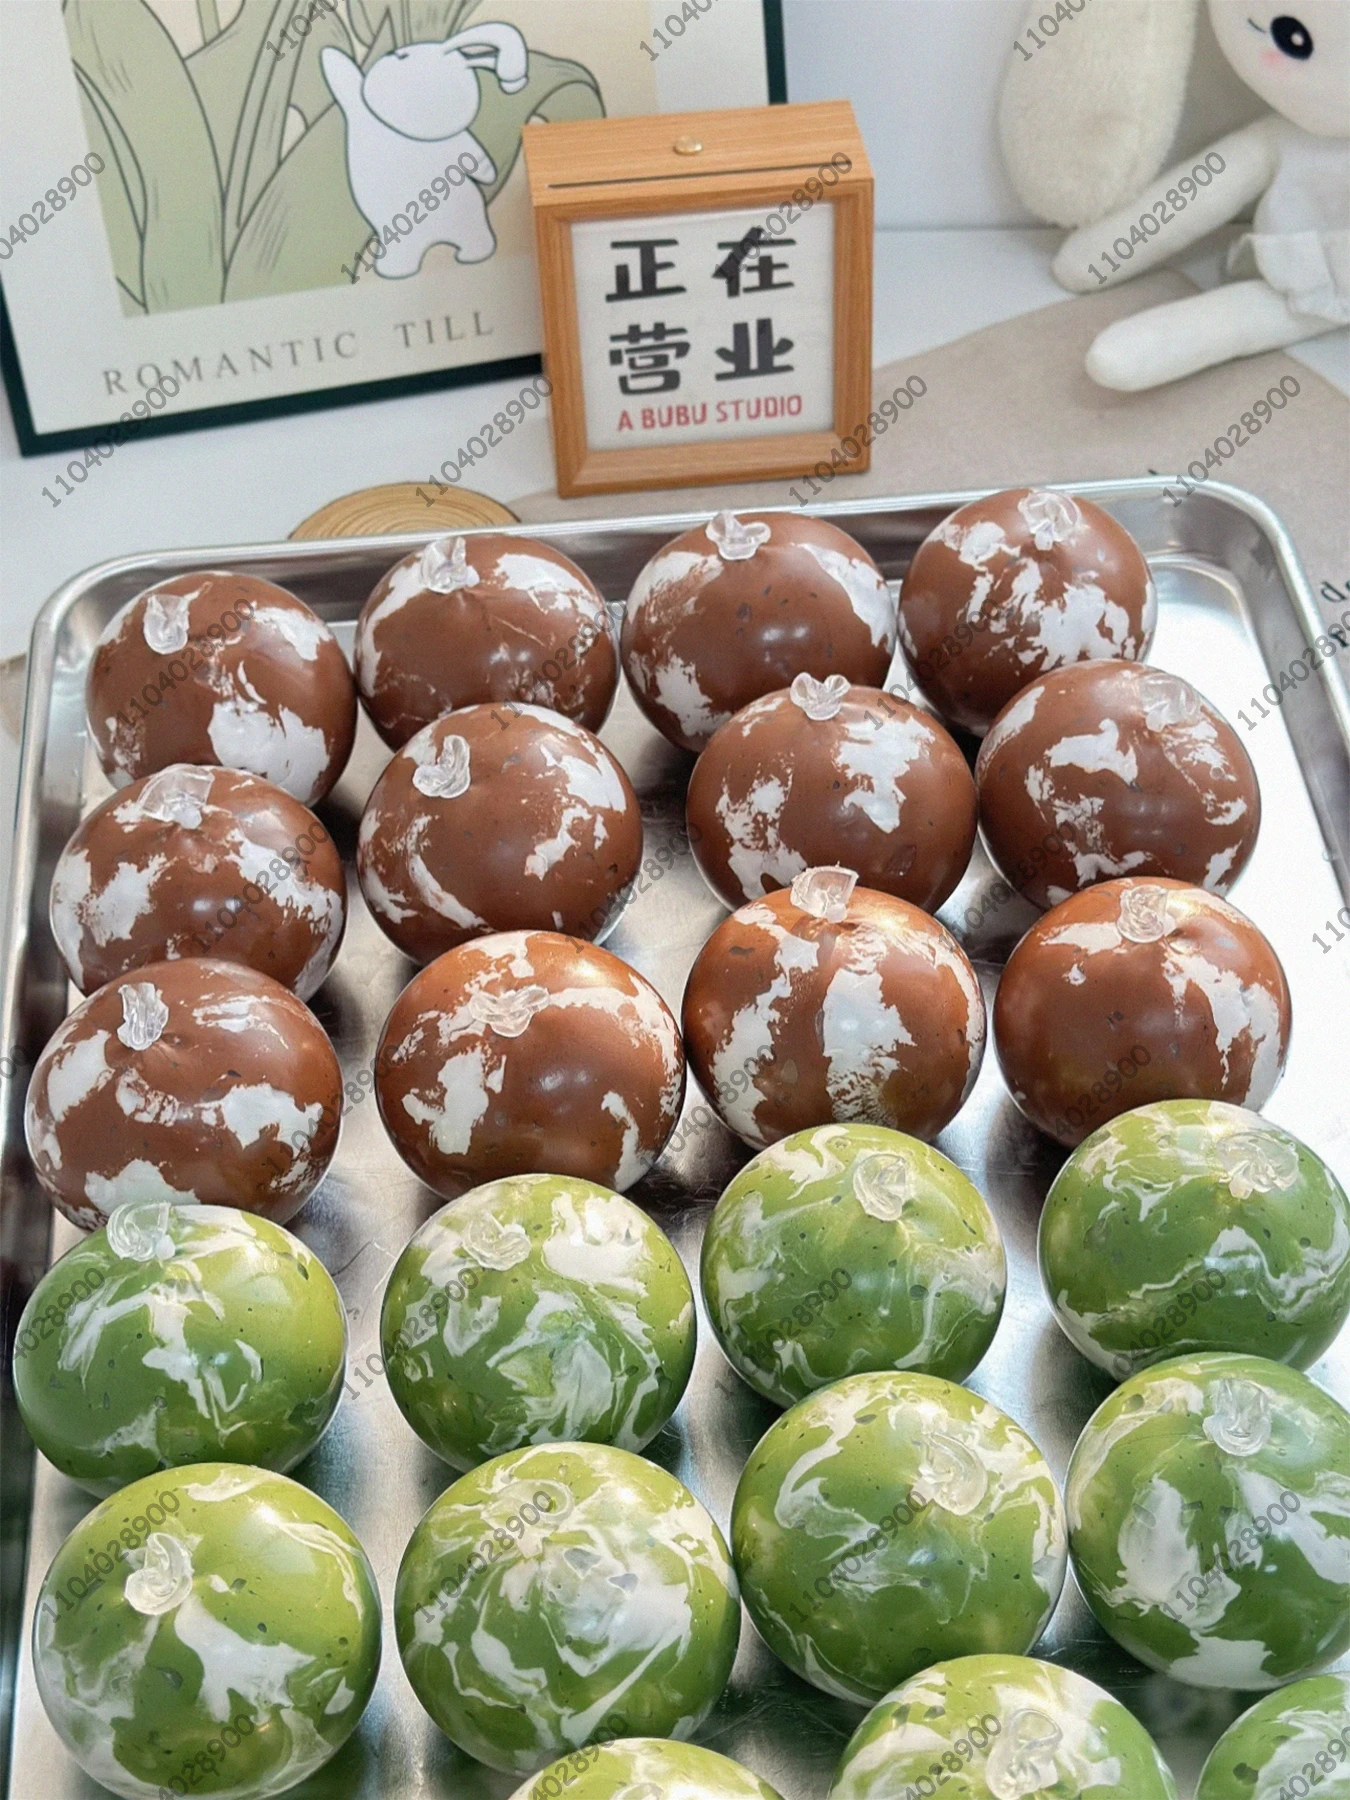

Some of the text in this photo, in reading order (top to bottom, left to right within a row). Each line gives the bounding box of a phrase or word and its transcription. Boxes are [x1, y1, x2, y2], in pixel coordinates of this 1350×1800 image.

[605, 226, 797, 302] 正在
[103, 311, 494, 395] ROMANTIC TILL
[609, 317, 795, 396] 营业
[617, 394, 803, 431] A BUBU STUDIO
